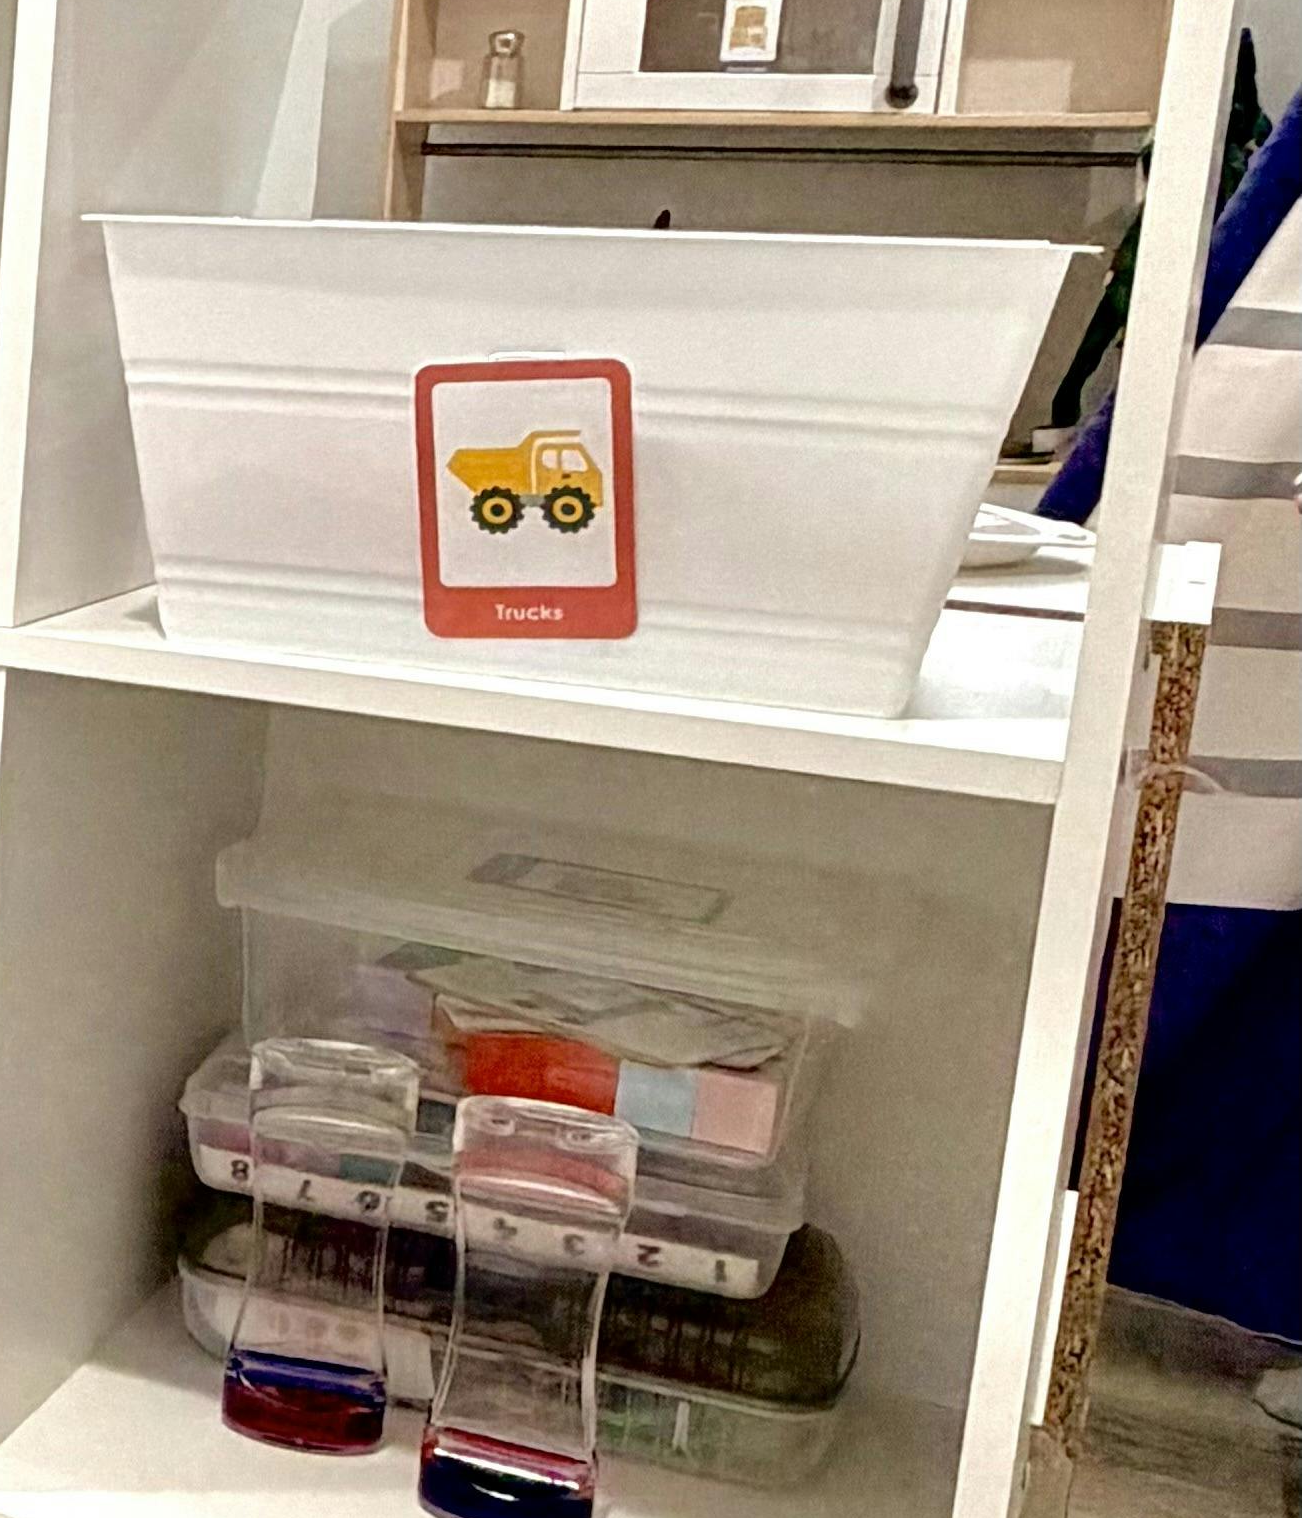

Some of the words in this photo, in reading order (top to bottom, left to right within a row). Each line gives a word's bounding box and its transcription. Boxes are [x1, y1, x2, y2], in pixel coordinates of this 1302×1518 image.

[494, 603, 564, 621] Trucks
[230, 1159, 251, 1181] 8
[424, 1199, 450, 1223] 5
[636, 1243, 662, 1268] 2
